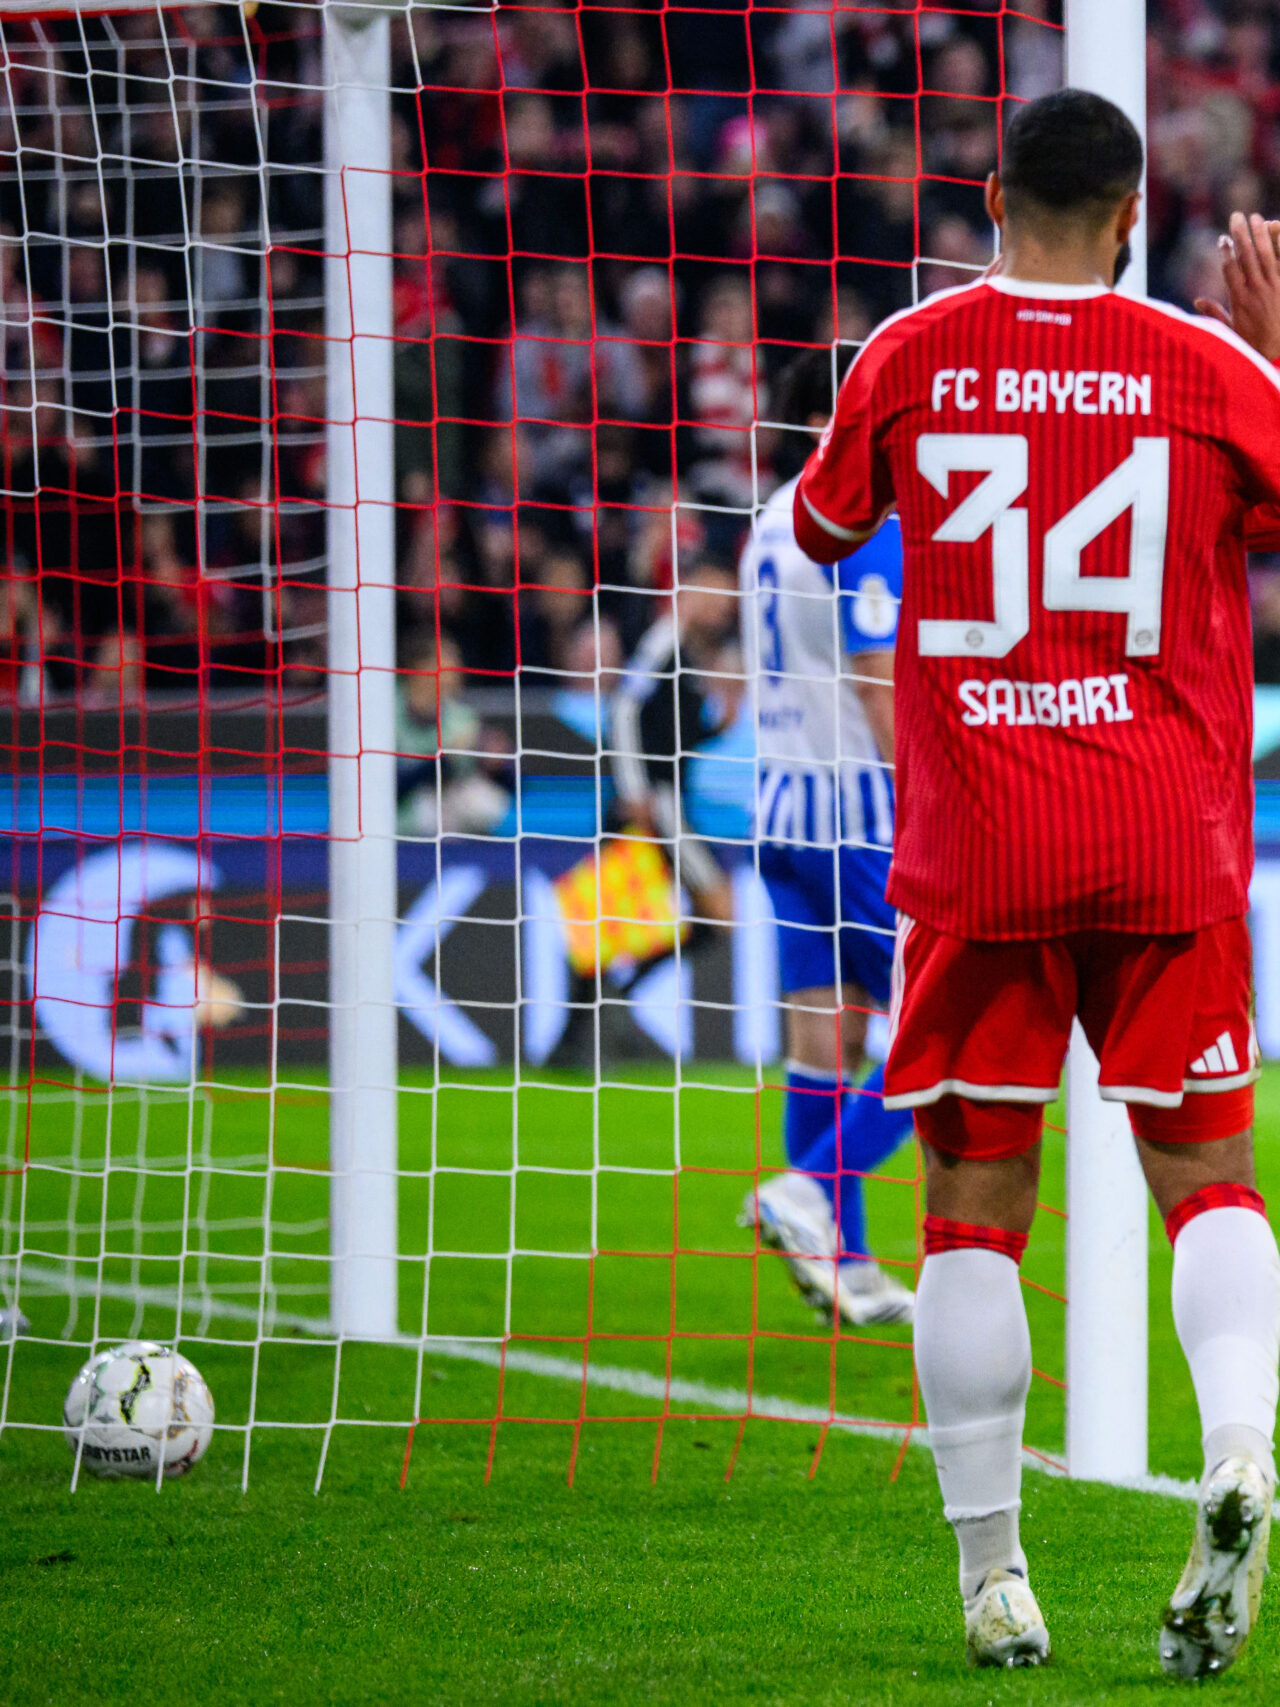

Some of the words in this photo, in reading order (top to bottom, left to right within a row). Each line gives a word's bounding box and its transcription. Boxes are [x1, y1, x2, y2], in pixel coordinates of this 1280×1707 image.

[931, 367, 980, 412] FC
[995, 368, 1152, 416] BAYERN
[916, 433, 1170, 659] 34
[958, 673, 1134, 727] SAIBARI
